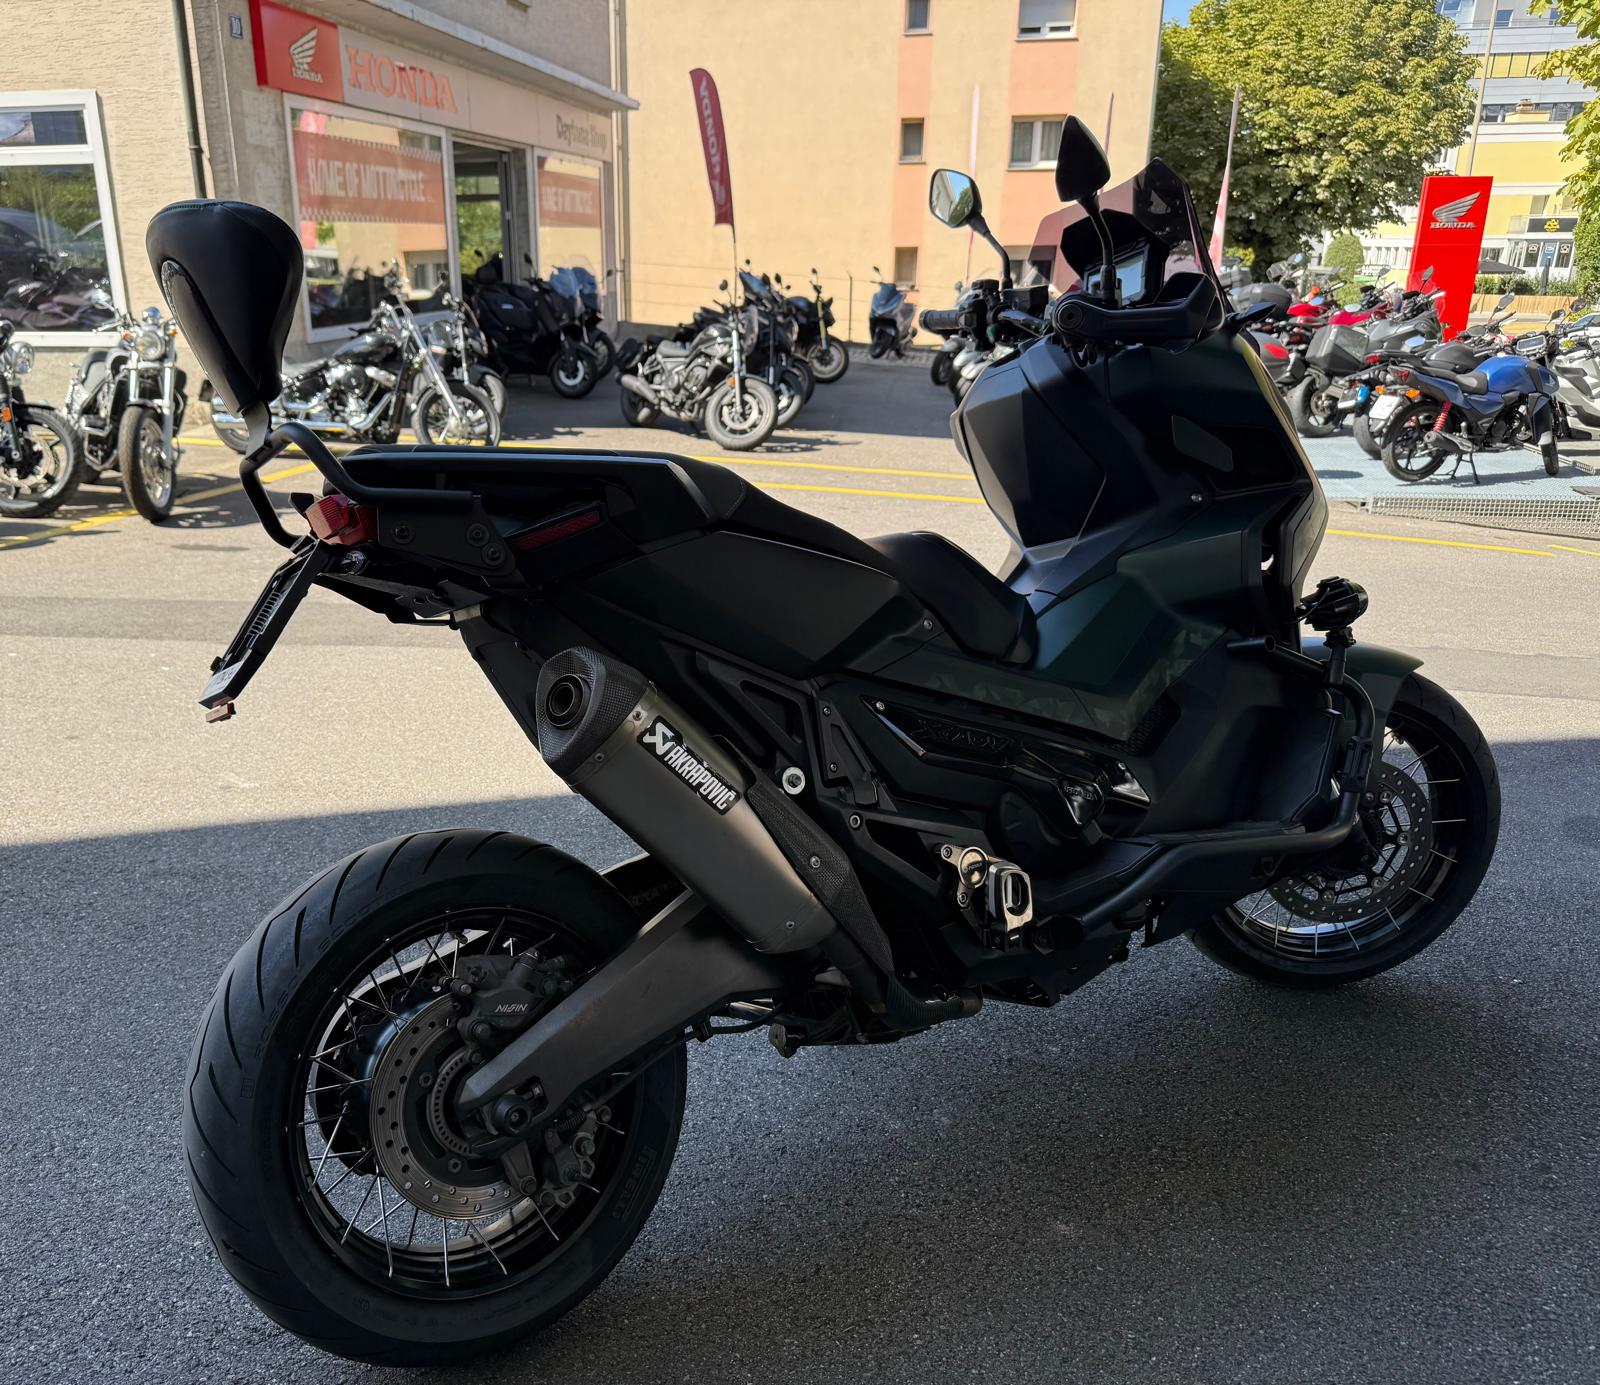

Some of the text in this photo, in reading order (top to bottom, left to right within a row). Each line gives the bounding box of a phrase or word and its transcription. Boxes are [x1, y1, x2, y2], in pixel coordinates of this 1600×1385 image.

[292, 67, 323, 83] HONDA
[346, 45, 458, 113] HONDA
[700, 76, 721, 175] HONDA
[307, 157, 345, 196] HOME
[345, 161, 359, 198] OF
[1430, 221, 1476, 229] HONDA
